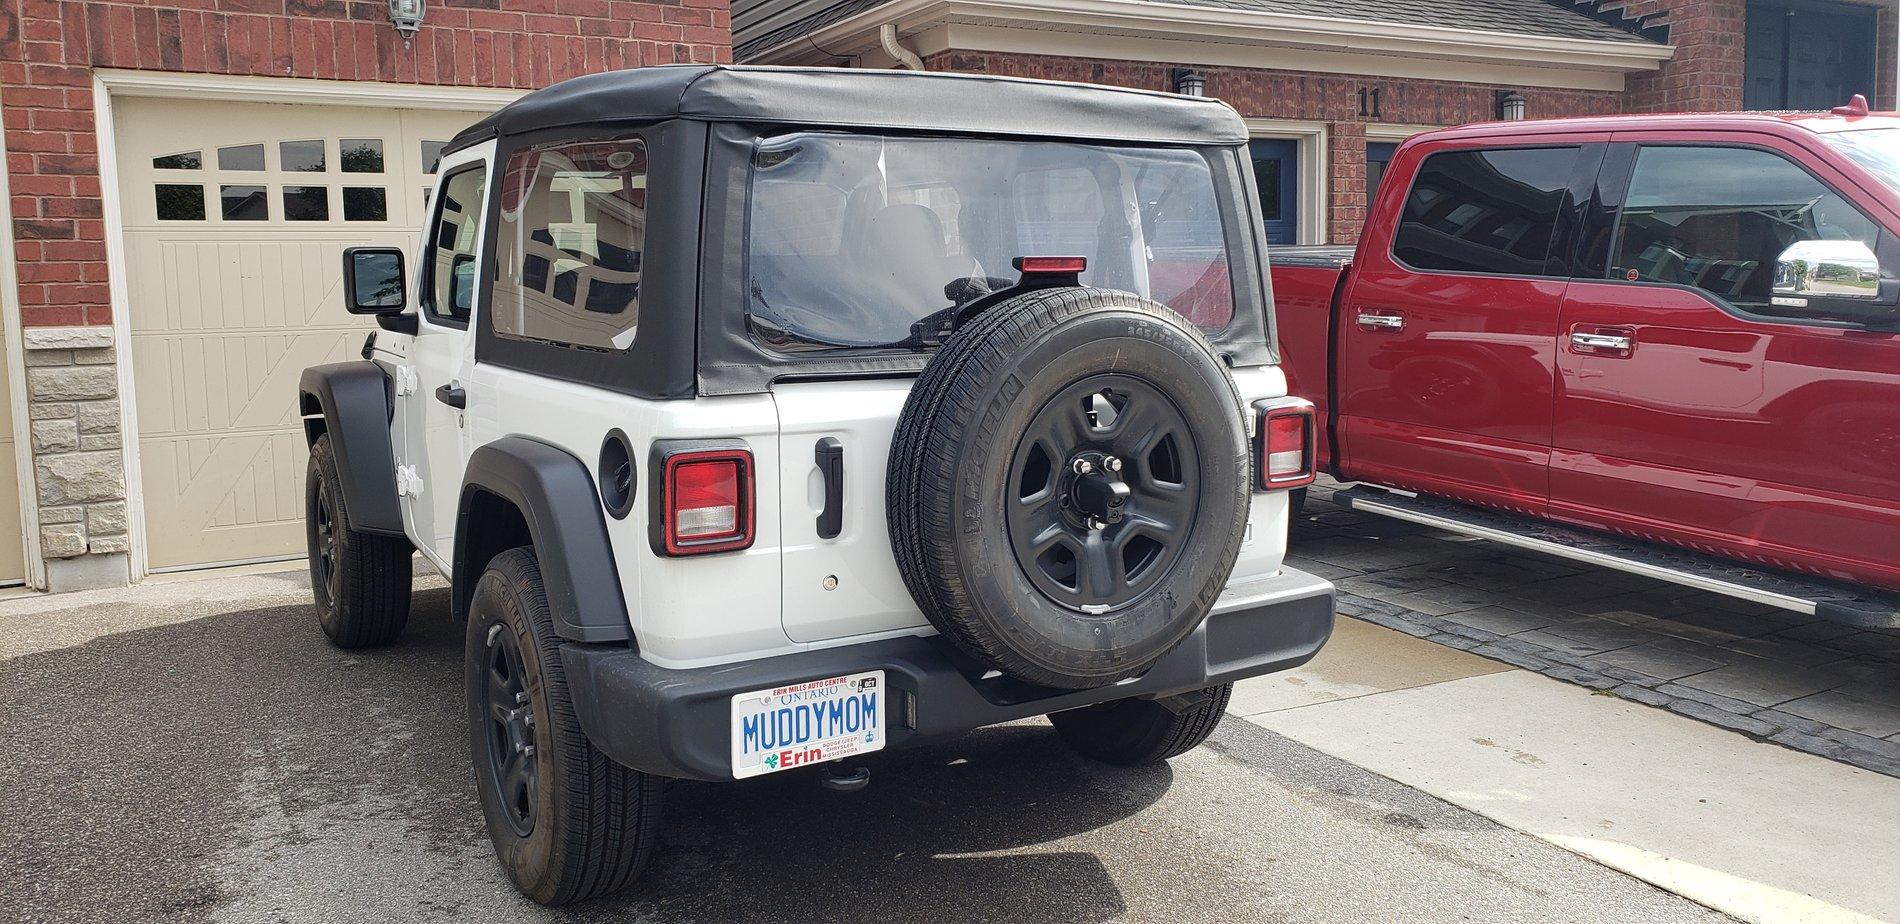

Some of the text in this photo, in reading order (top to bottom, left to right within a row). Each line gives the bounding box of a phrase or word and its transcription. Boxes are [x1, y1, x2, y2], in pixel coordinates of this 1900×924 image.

[1358, 87, 1380, 117] 11
[788, 684, 807, 693] MILLS
[808, 681, 824, 690] AUTO
[824, 677, 848, 687] CENTRE
[864, 680, 875, 688] OCT
[780, 686, 838, 706] ONTARIO
[743, 692, 876, 754] MUDDYMOM
[780, 748, 822, 767] Erin
